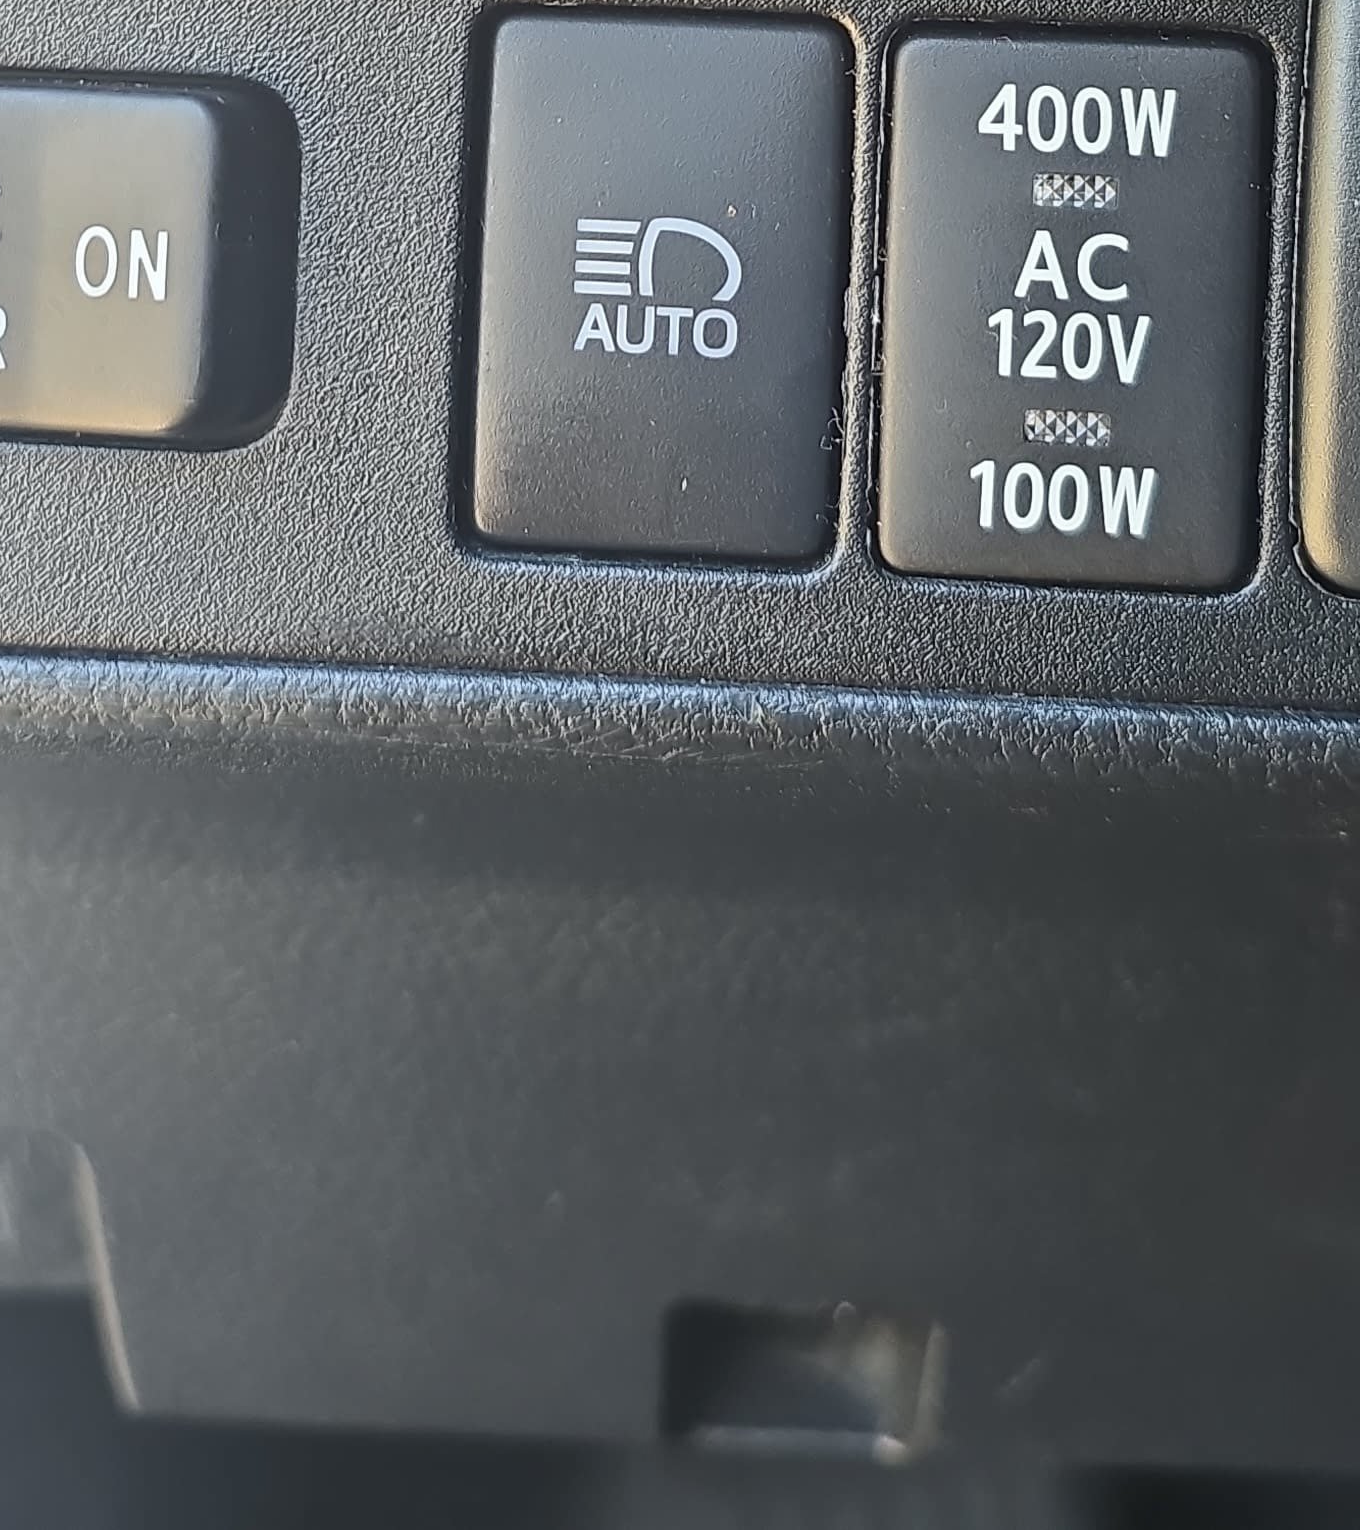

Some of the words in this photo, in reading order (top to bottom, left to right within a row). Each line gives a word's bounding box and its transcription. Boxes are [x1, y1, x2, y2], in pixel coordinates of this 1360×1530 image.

[977, 84, 1178, 158] 400W
[74, 225, 170, 301] ON
[1014, 230, 1131, 302] AC
[573, 302, 739, 360] AUTO
[988, 309, 1153, 385] 120V
[969, 460, 1159, 538] 100W
